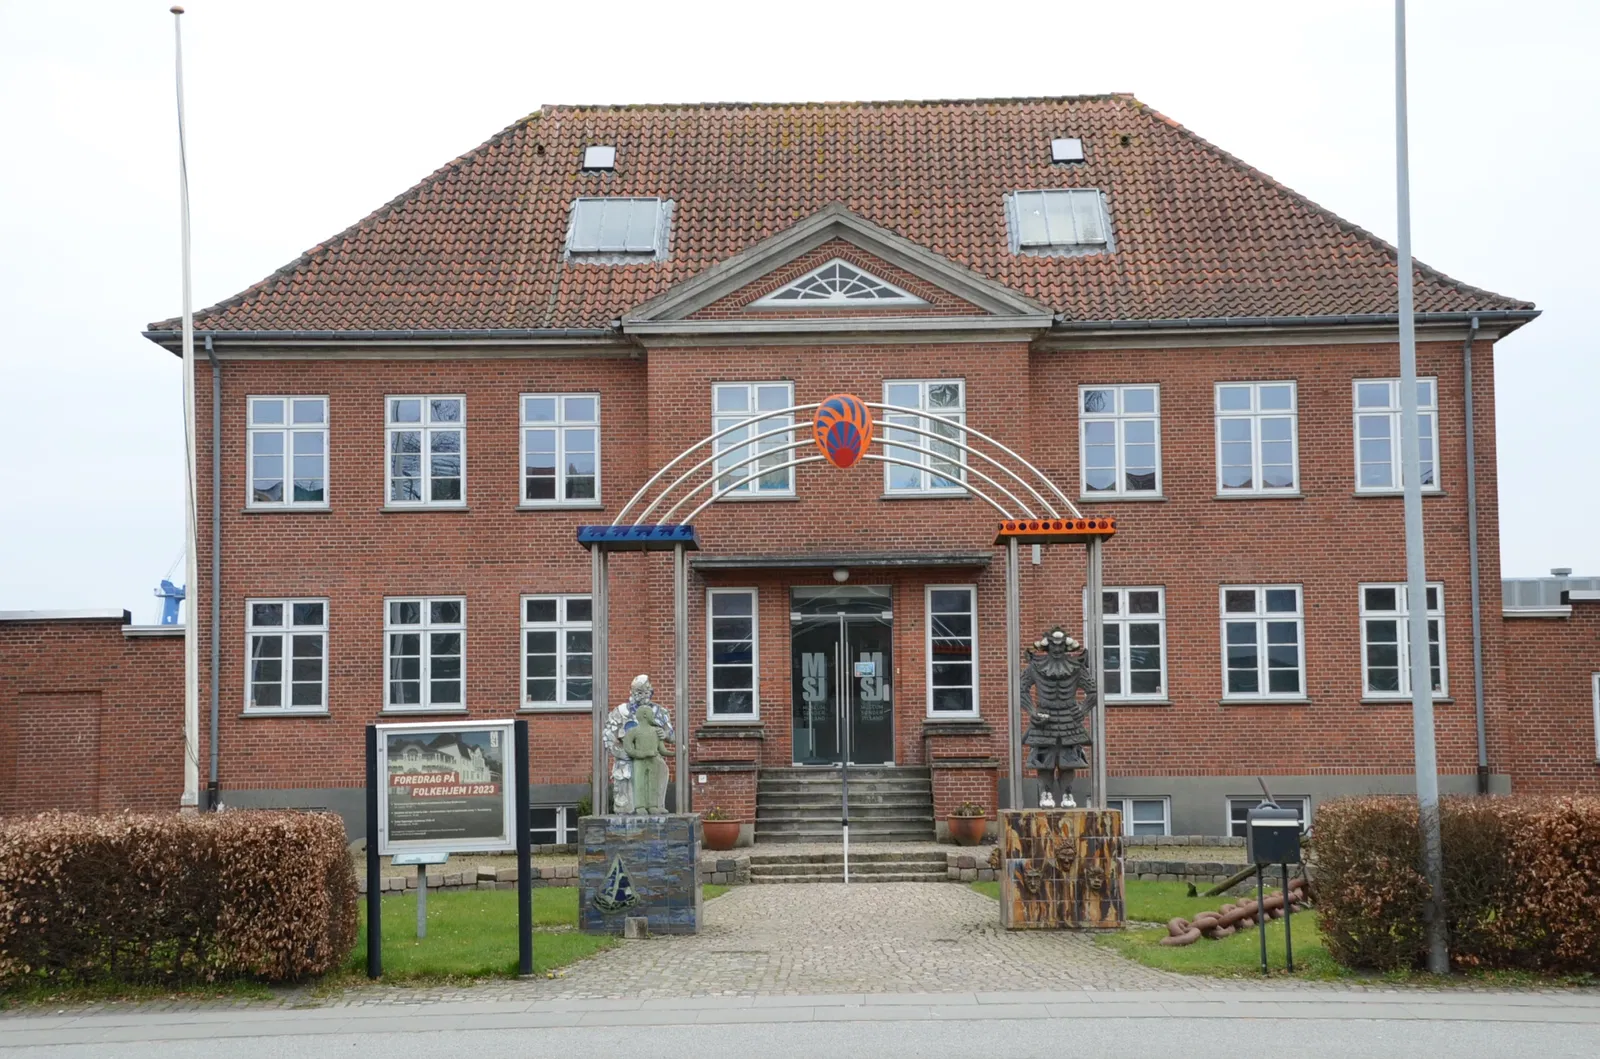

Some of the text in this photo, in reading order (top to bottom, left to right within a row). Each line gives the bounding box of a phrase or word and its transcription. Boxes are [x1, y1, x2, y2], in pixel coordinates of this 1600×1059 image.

[802, 653, 824, 677] M
[802, 677, 826, 701] SJ
[860, 677, 883, 701] SJ
[394, 772, 455, 785] FOREDRAG PÅ
[412, 785, 466, 797] FOLKEHJEM
[473, 785, 494, 794] 2023
